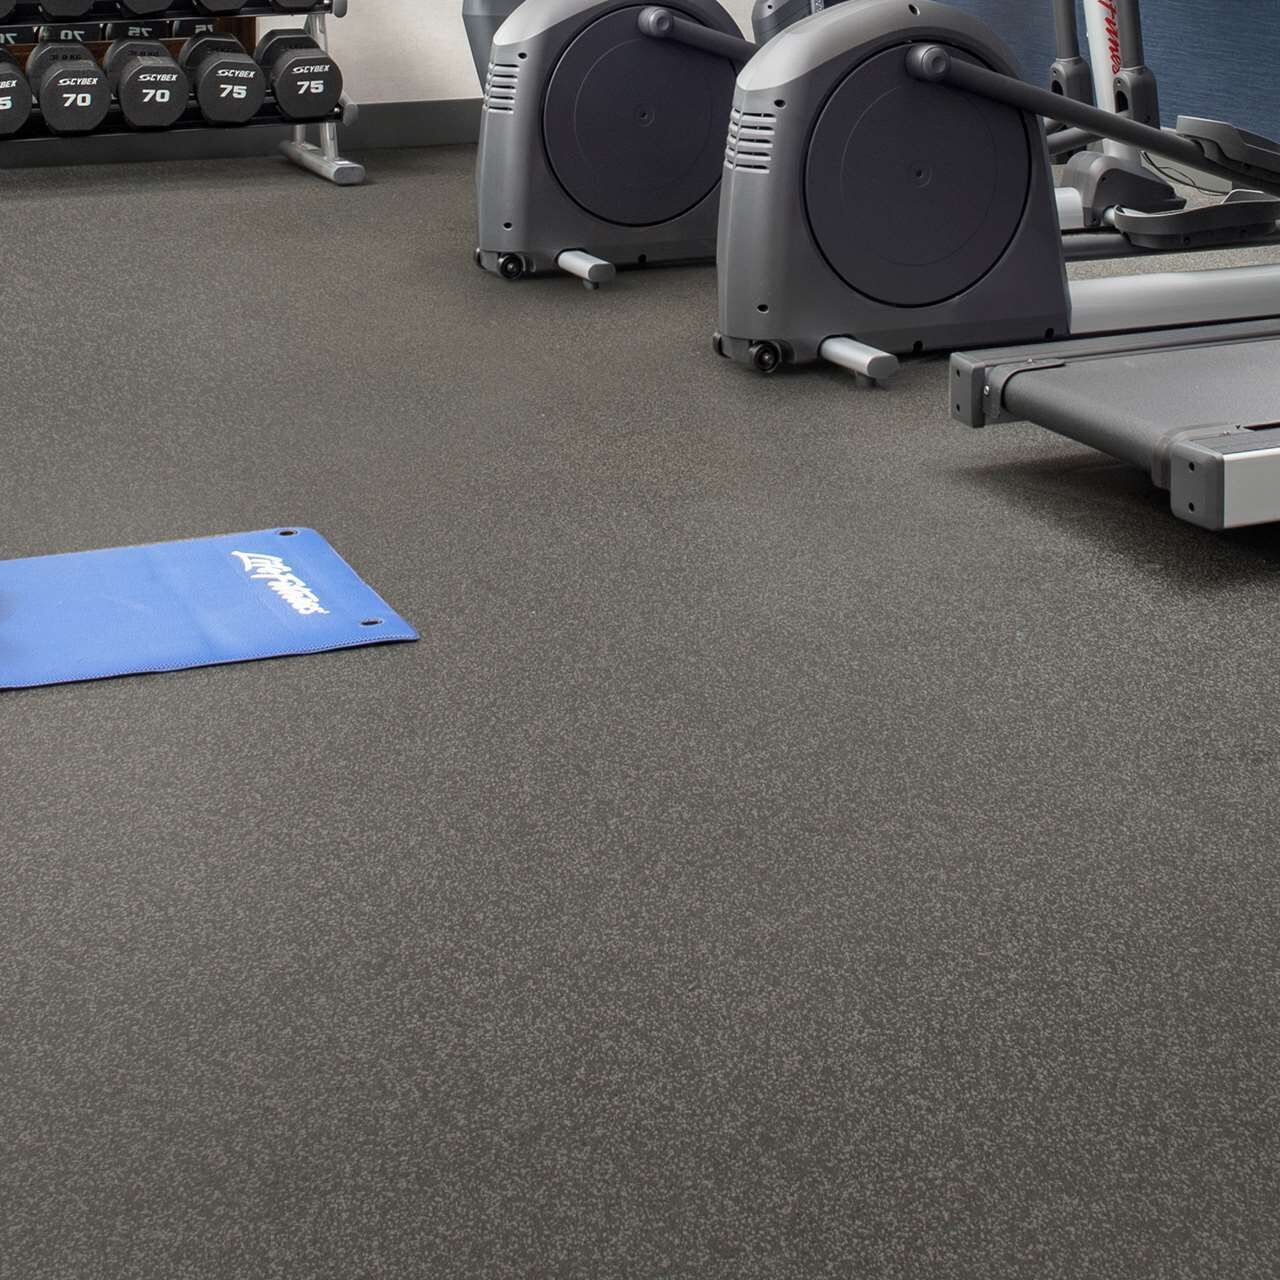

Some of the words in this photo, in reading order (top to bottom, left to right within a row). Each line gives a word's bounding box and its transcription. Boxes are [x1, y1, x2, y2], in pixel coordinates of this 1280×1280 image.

[304, 64, 330, 73] CYBEX
[220, 85, 247, 98] 75
[297, 81, 323, 94] 75
[63, 94, 91, 106] 70
[143, 90, 169, 102] 70
